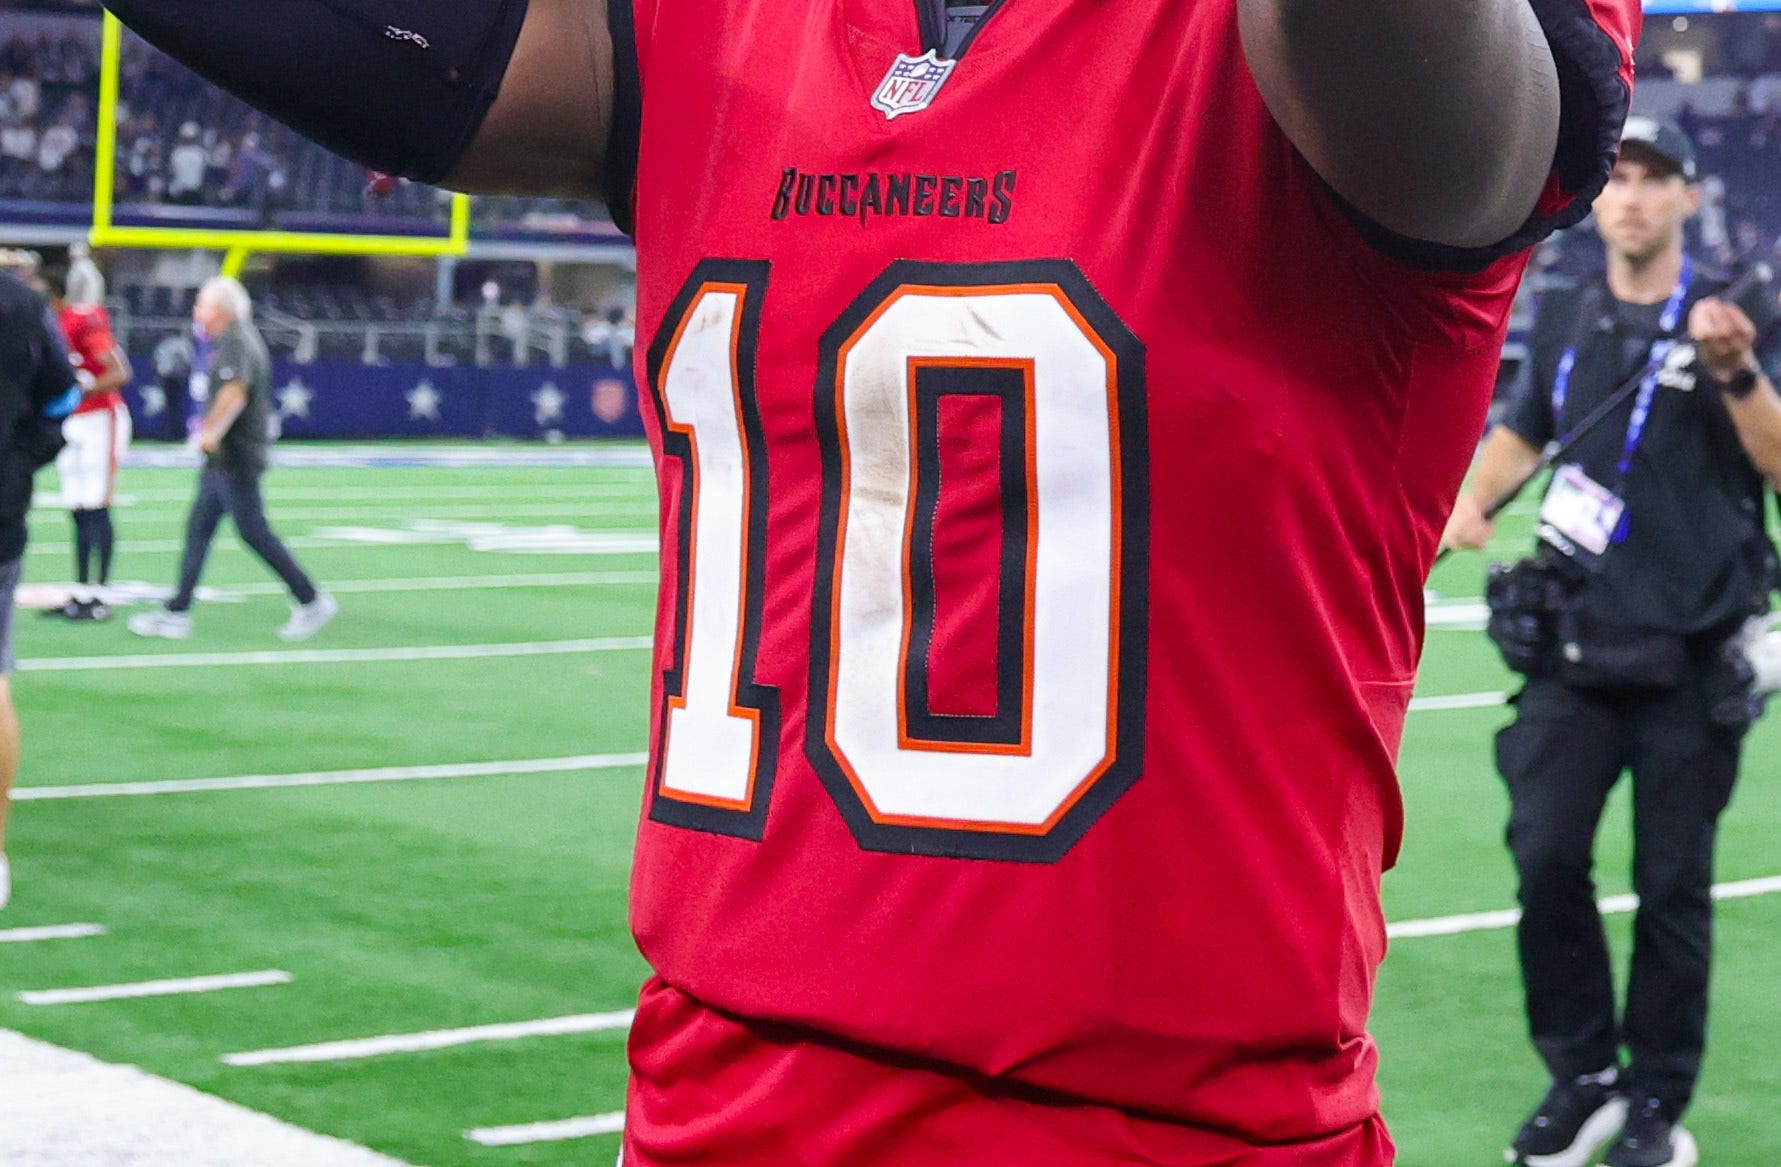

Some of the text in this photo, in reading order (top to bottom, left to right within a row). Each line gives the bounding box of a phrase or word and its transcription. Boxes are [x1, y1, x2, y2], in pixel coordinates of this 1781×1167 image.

[882, 79, 927, 104] NFL
[771, 167, 1017, 228] BUCCANEERS
[648, 258, 1149, 864] 10
